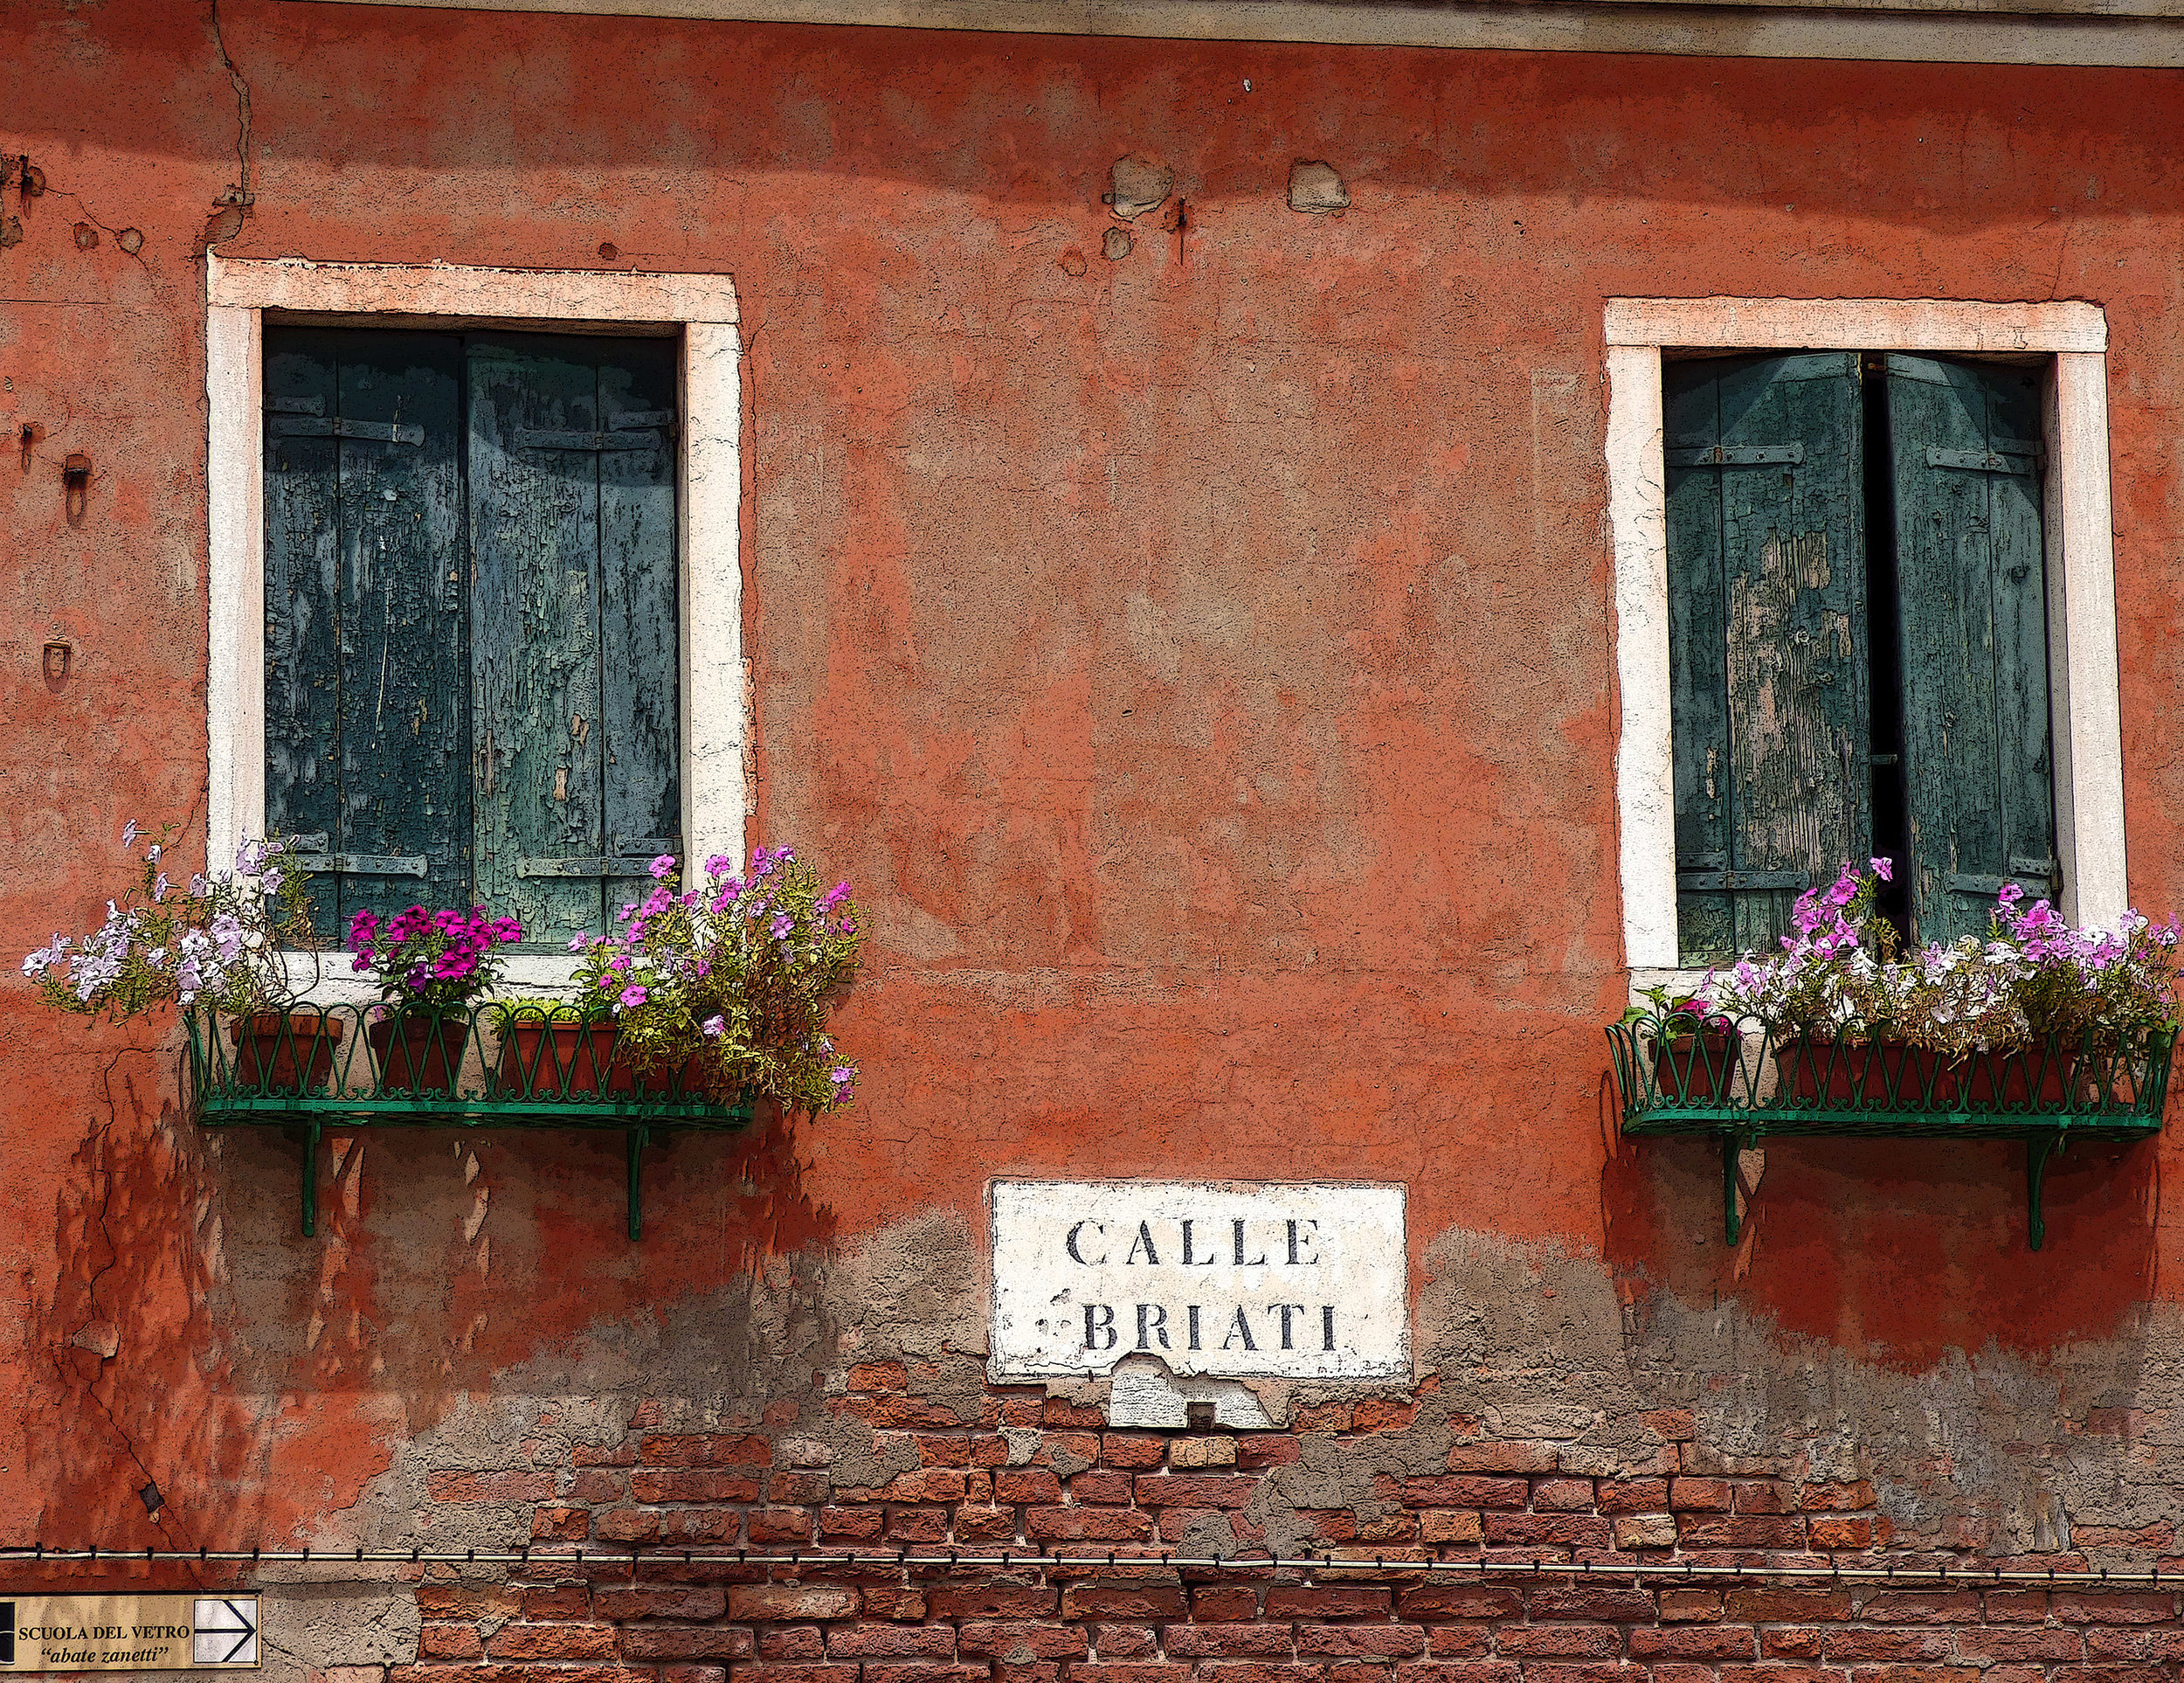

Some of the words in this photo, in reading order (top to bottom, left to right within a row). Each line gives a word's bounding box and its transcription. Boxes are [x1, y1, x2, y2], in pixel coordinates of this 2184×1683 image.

[1066, 1219, 1319, 1266] CALLE
[1083, 1304, 1336, 1351] BRIATI
[18, 1626, 88, 1640] SCUOLA
[93, 1626, 128, 1639] DEL
[132, 1625, 190, 1639] VETRO
